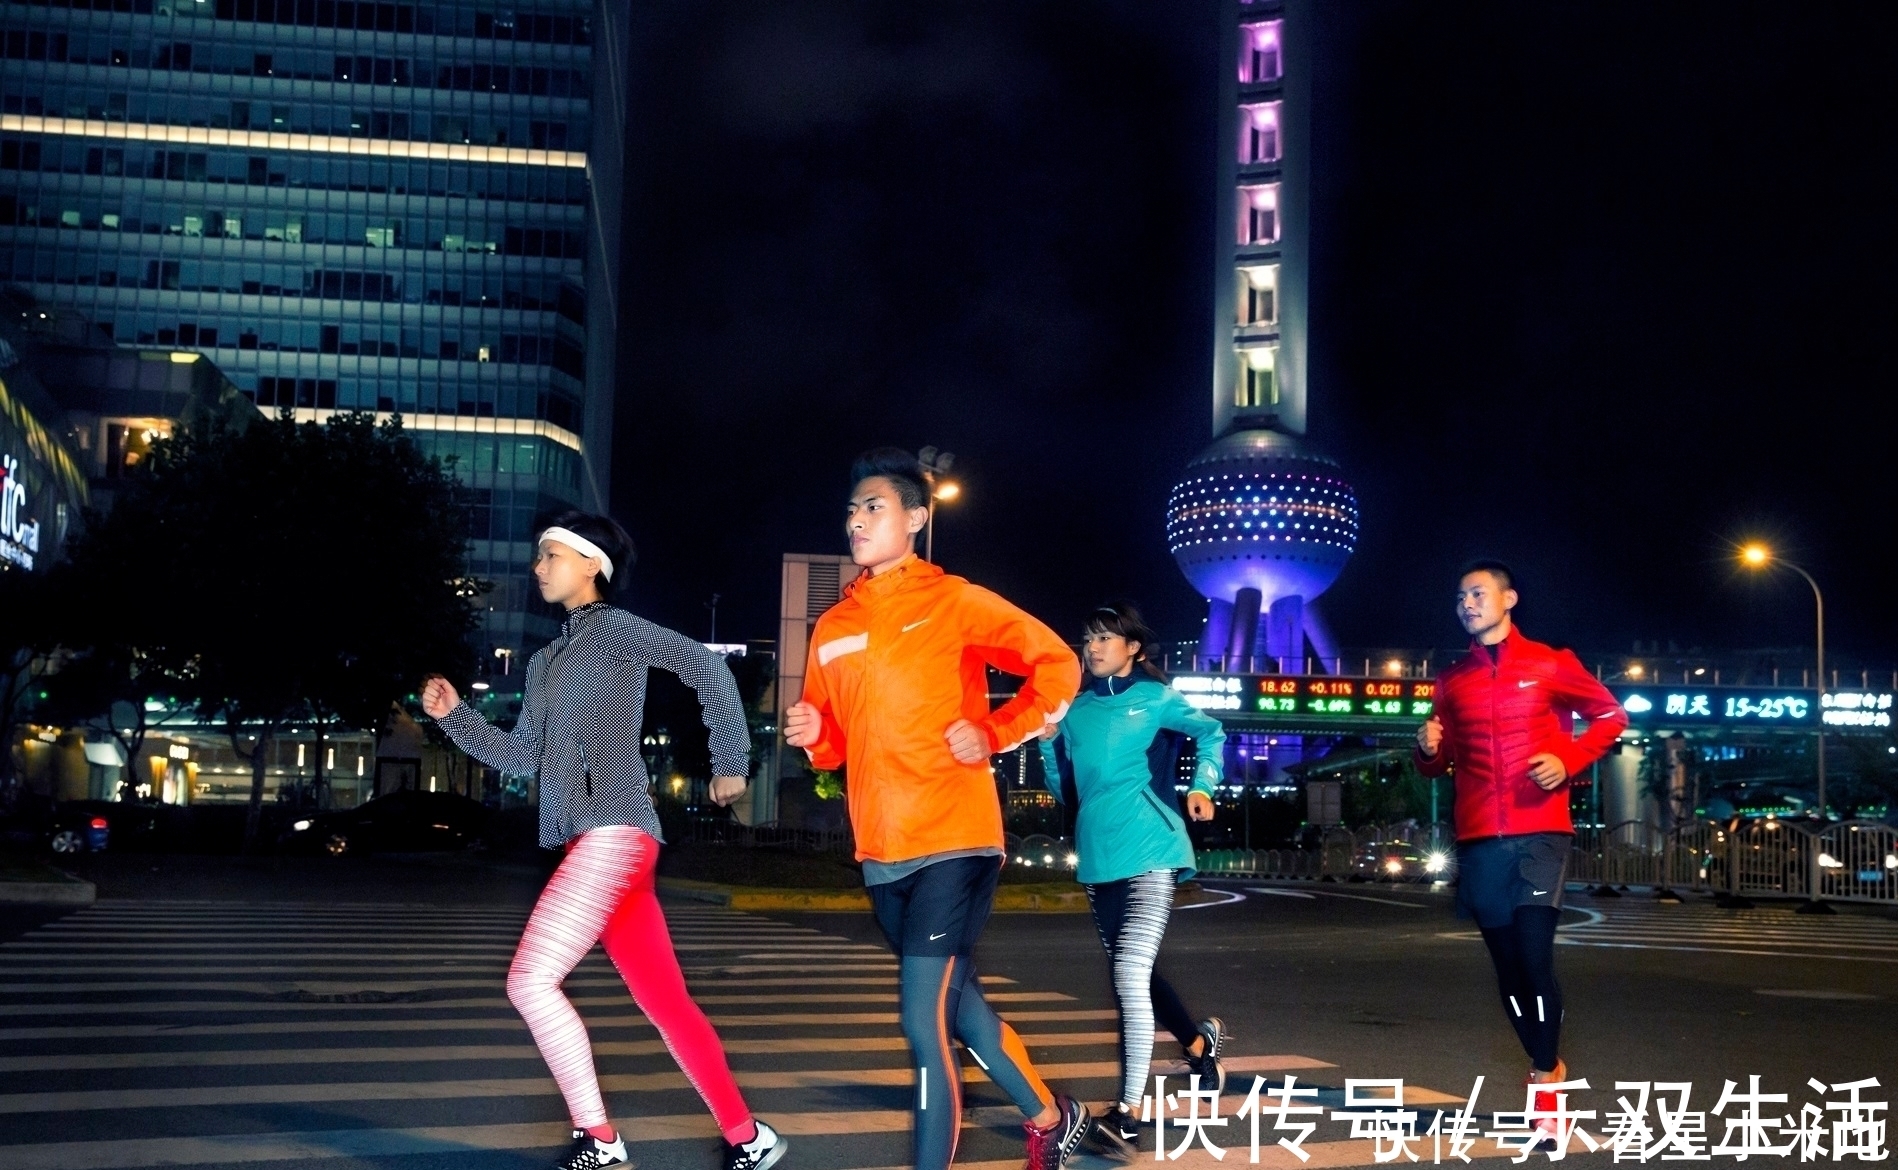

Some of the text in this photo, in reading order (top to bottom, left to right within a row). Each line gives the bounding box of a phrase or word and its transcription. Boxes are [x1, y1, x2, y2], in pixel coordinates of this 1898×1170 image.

[1261, 681, 1296, 694] 18.62
[1308, 682, 1353, 695] +0.11%
[1366, 683, 1401, 696] 0.021
